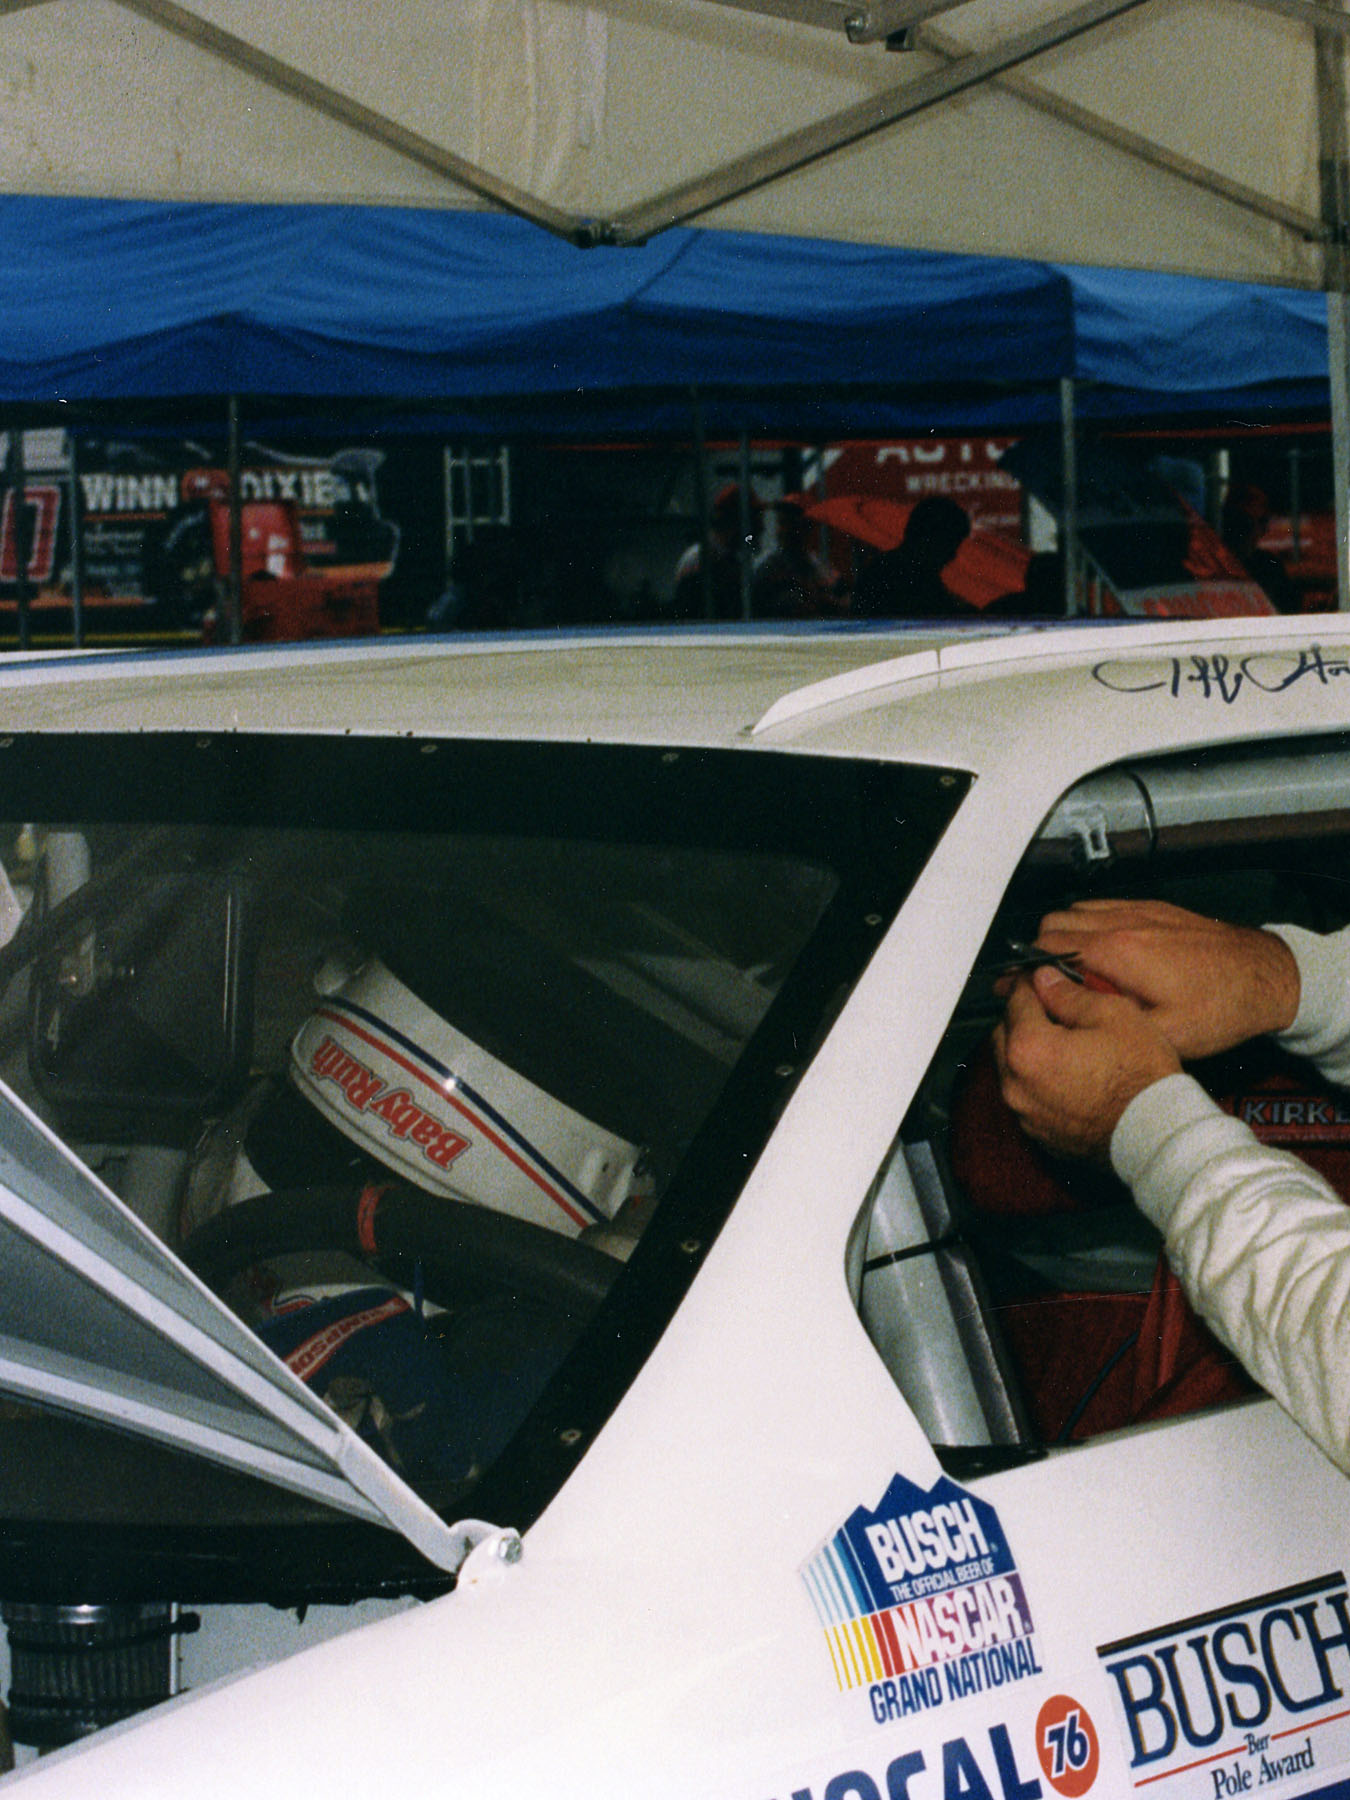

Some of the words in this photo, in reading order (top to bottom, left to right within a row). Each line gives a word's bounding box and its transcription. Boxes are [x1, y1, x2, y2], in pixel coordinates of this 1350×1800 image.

[80, 473, 177, 511] WINN
[312, 1037, 385, 1111] Ruth
[369, 1089, 471, 1170] Baby
[865, 1498, 990, 1583] BUSCH
[889, 1582, 915, 1602] THE
[914, 1570, 955, 1597] OFFICIAL
[954, 1562, 982, 1585] BEER
[980, 1556, 996, 1576] OF
[890, 1576, 1026, 1672] NASCAR
[868, 1665, 944, 1725] GRAND
[943, 1636, 1043, 1702] NATIONAL
[1044, 1709, 1090, 1779] 76
[1210, 1761, 1253, 1800] Pole
[1258, 1737, 1316, 1786] Award
[1243, 1732, 1271, 1756] Beer
